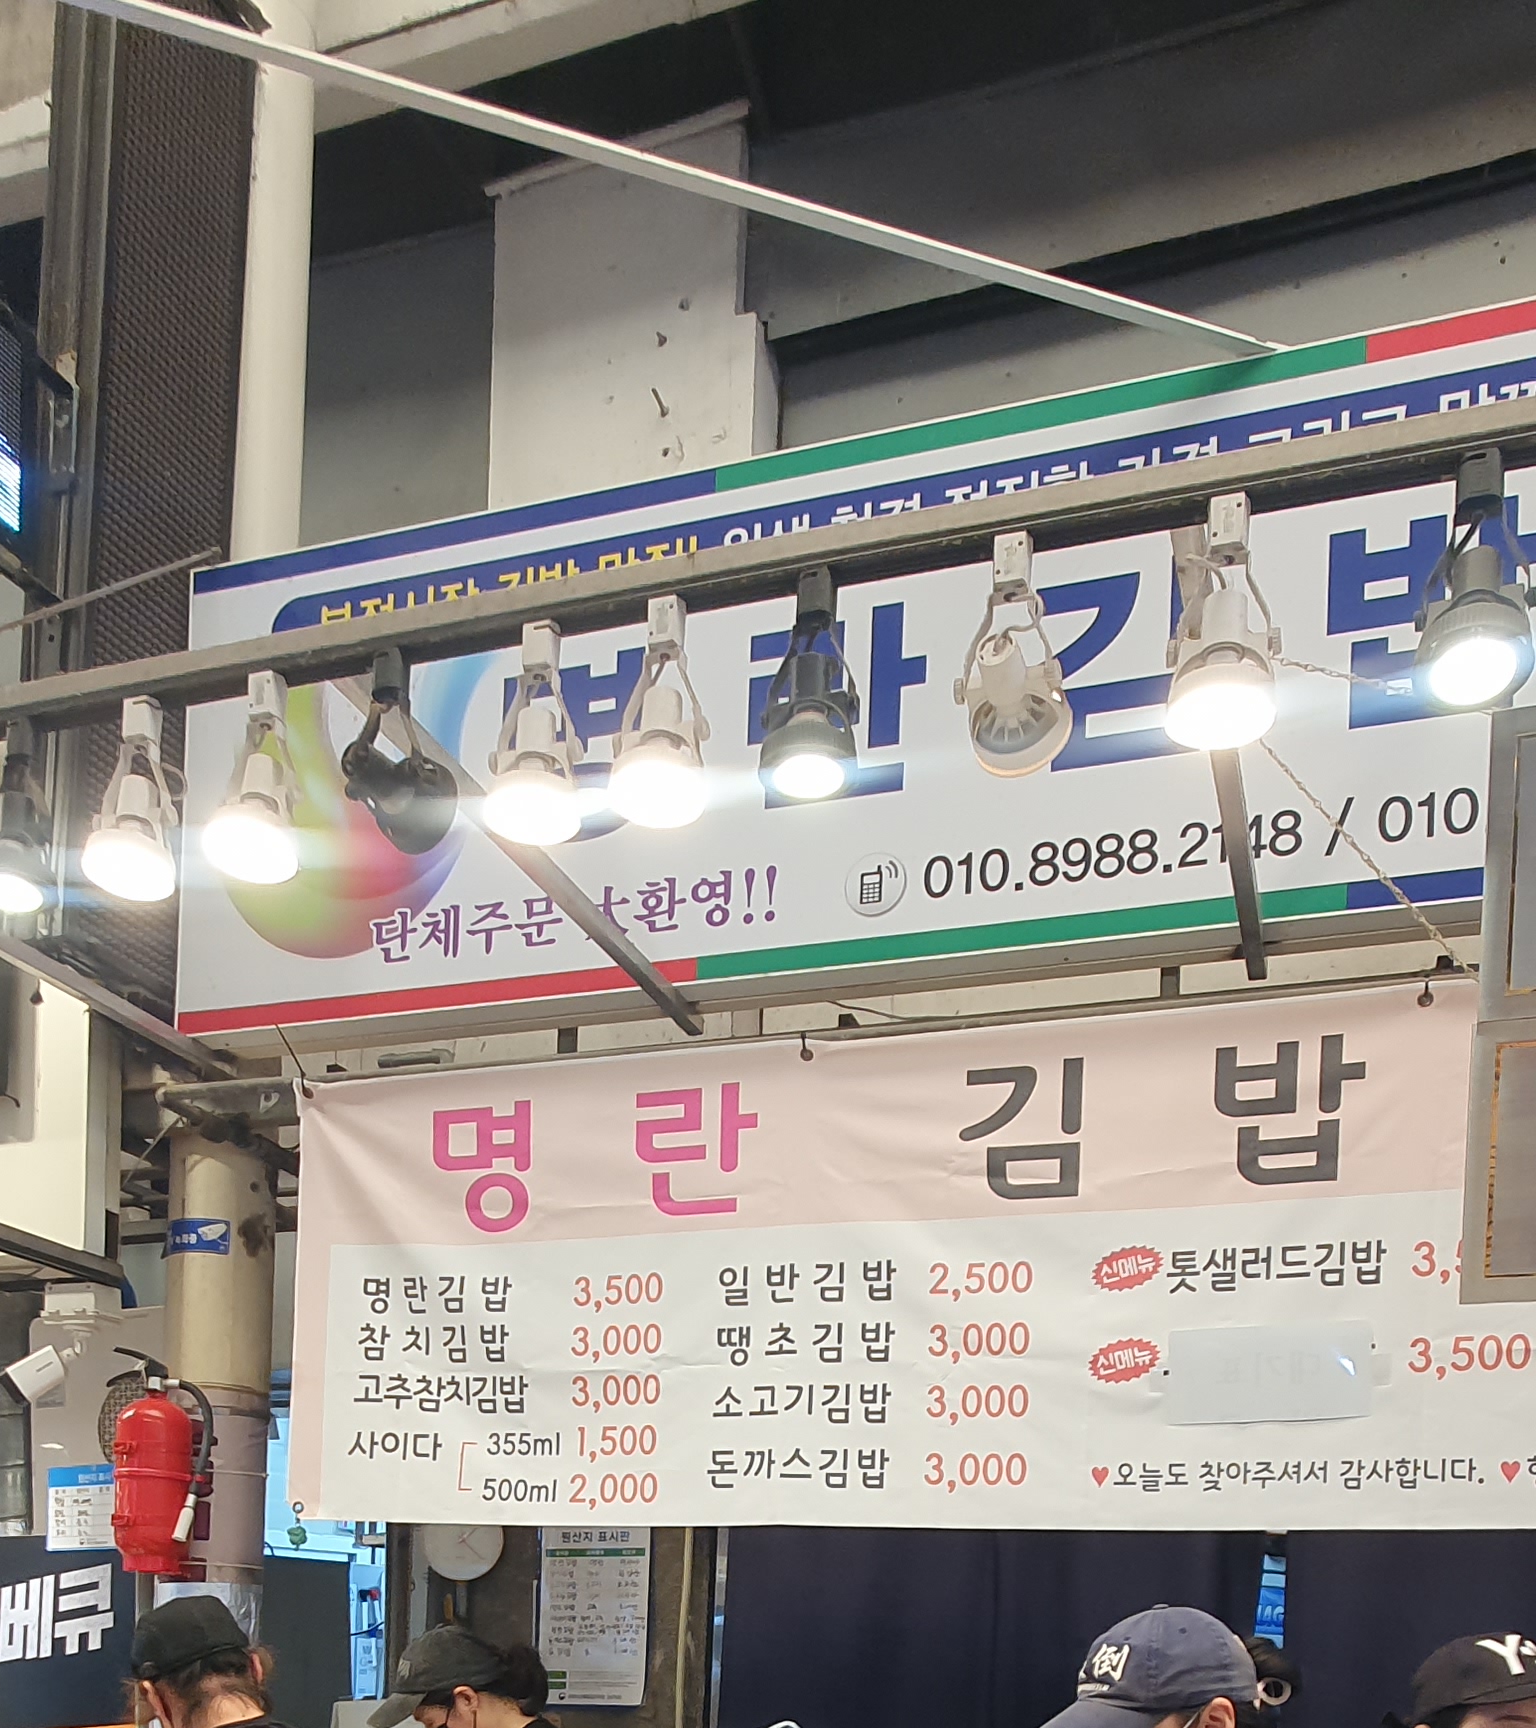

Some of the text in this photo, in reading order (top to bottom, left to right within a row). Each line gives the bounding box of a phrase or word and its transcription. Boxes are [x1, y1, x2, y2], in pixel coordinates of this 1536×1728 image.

[928, 1259, 1033, 1302] 2,500
[1165, 1239, 1388, 1293] 톳샐러드김밥
[573, 1272, 664, 1313] 3,500
[570, 1321, 663, 1363] 3,000
[927, 1321, 1032, 1363] 3,000
[1407, 1333, 1533, 1382] 3,500
[353, 1372, 662, 1416] 고추참치김밥 3,000
[712, 1380, 1030, 1427] 소고기김밥 3,000
[348, 1424, 658, 1463] 사이다 355ml 1,500
[706, 1448, 1028, 1491] 돈까스김밥 3,000
[1112, 1460, 1190, 1491] 오늘도
[1199, 1459, 1330, 1492] 찾아주셔서
[1339, 1455, 1486, 1491] 감사합니다.
[481, 1472, 659, 1510] 500ml 2,000
